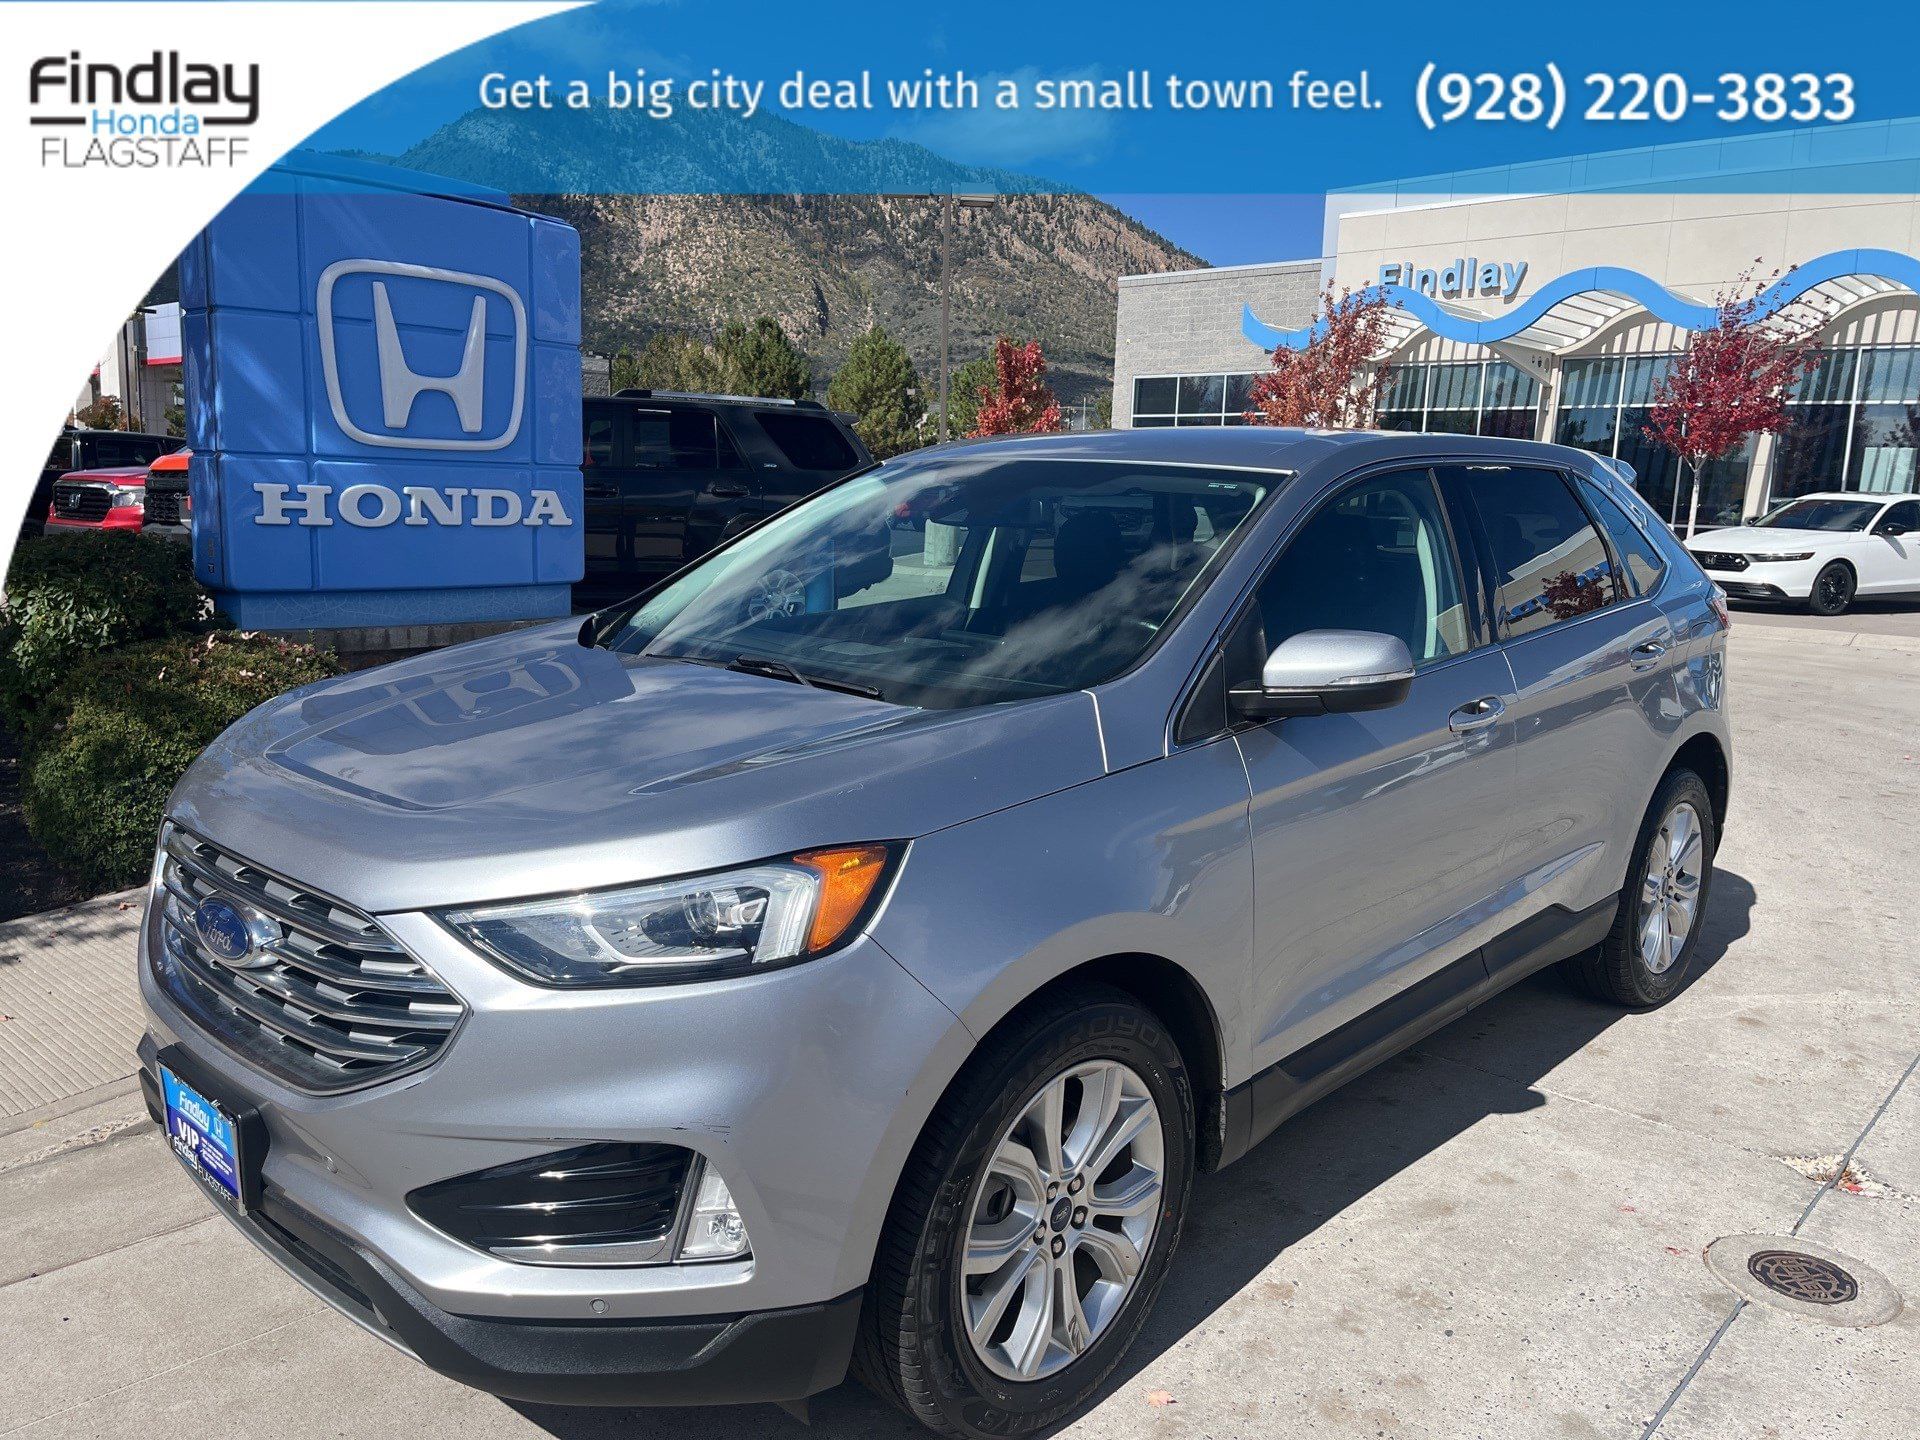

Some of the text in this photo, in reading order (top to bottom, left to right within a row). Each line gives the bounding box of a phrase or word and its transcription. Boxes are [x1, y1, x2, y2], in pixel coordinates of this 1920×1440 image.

[1379, 257, 1528, 297] Findlay
[253, 482, 573, 527] HONDA
[201, 906, 237, 952] Ford
[177, 1116, 200, 1150] VIP
[179, 1090, 210, 1133] Findlay
